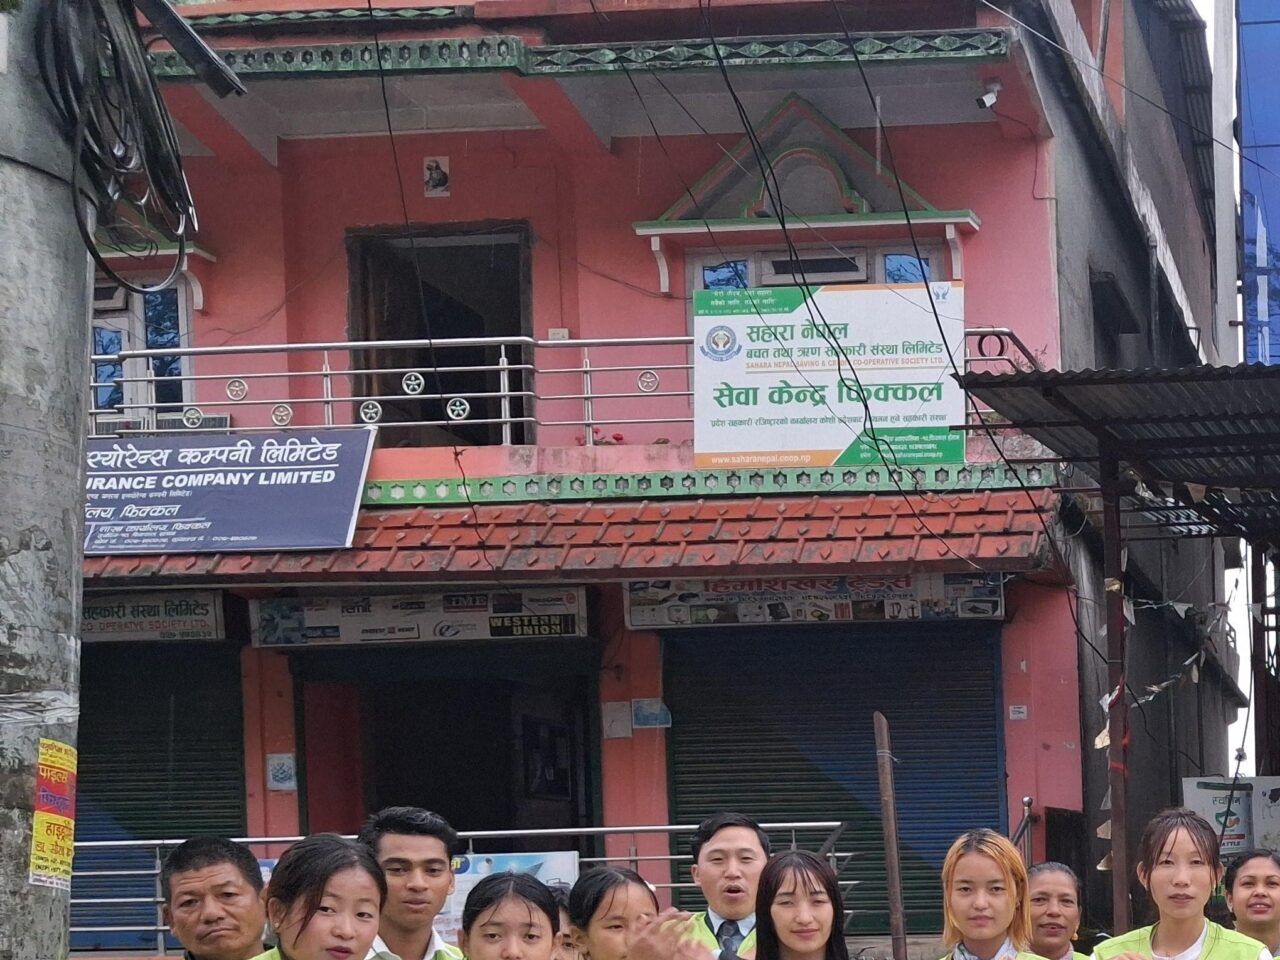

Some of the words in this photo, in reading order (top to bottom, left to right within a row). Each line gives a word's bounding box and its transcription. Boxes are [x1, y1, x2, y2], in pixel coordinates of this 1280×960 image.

[746, 323, 795, 343] सहारा
[801, 319, 849, 340] नेपाल
[746, 347, 769, 359] बचत
[773, 347, 794, 359] तथा
[871, 342, 898, 356] संस्था
[902, 340, 943, 355] लिमिटेड
[746, 361, 772, 369] SAHARA
[852, 358, 899, 367] CO-OPERATIVE
[901, 357, 928, 365] SOCIETY
[930, 356, 945, 364] LTD.
[713, 382, 760, 408] सेवा
[768, 380, 828, 407] केन्द्र
[837, 378, 945, 403] फिक्कल
[86, 443, 172, 470] स्योरेन्स
[178, 440, 254, 466] कम्पनी
[260, 437, 342, 464] लिमिटेड
[162, 472, 255, 489] COMPANY
[258, 469, 336, 486] LIMITED
[120, 503, 182, 519] फिक्कल
[164, 599, 211, 618] लिमिटेड
[490, 615, 561, 628] WESTERN
[512, 625, 562, 636] UNION
